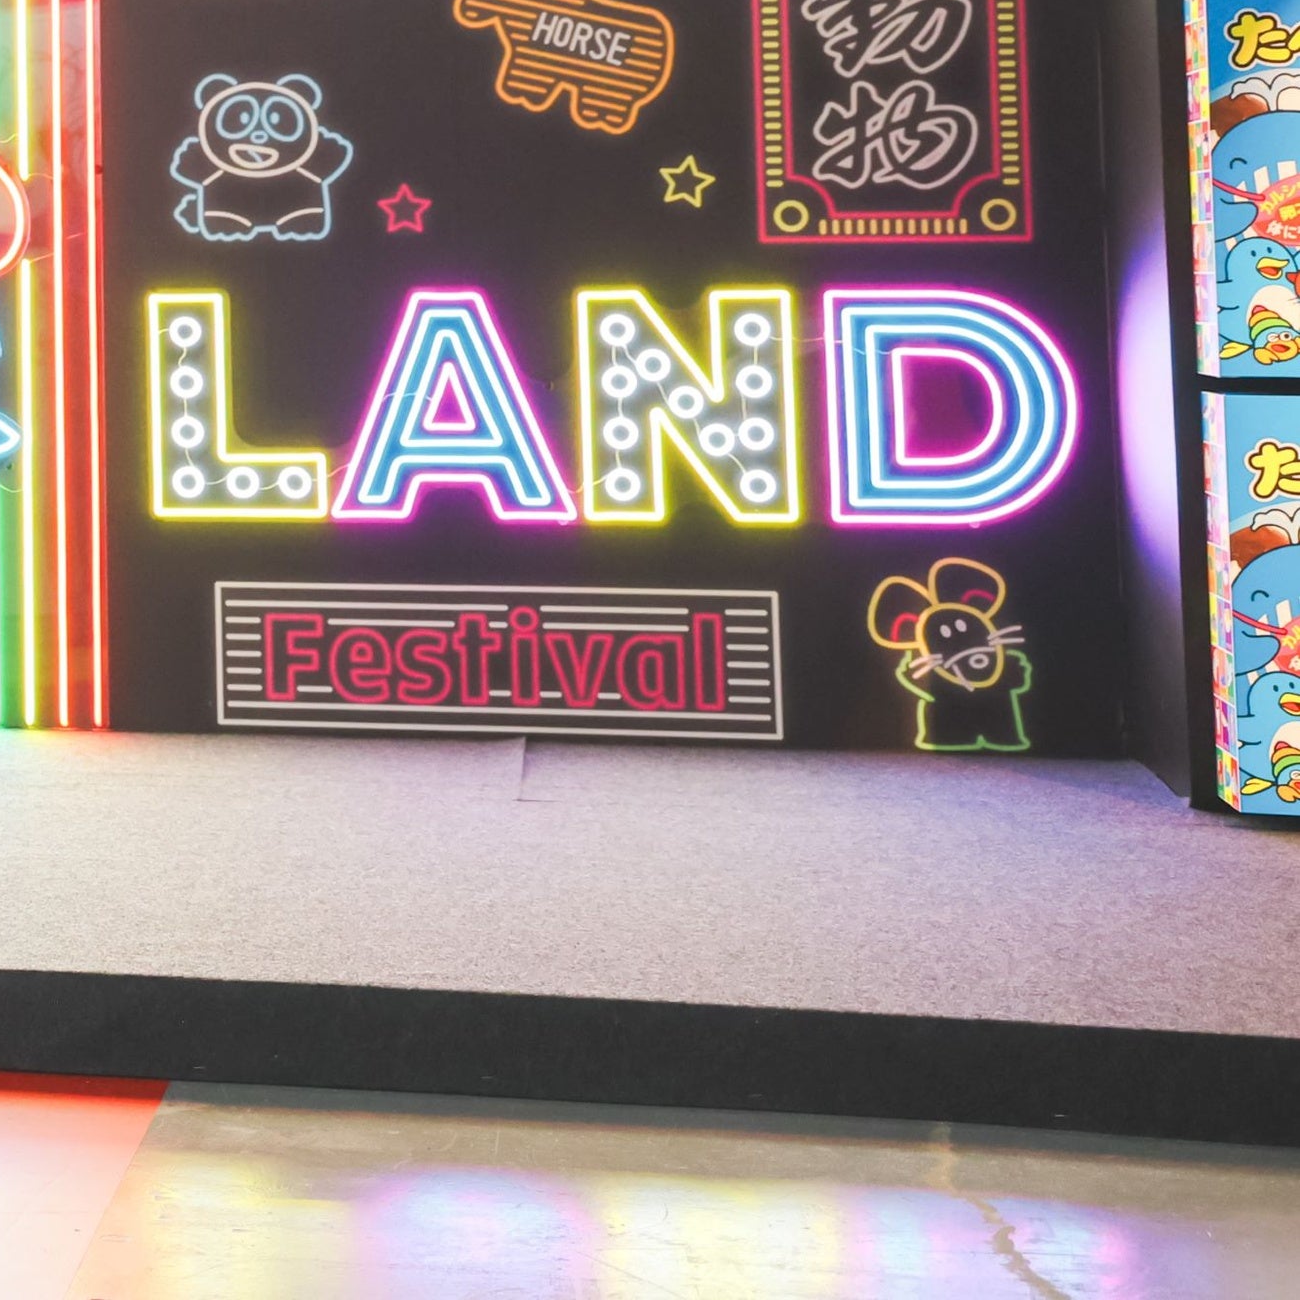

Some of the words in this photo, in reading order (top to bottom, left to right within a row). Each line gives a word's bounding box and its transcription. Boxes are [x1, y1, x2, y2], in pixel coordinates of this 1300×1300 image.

[531, 11, 631, 67] HORSE
[1226, 10, 1300, 68] た
[147, 288, 1079, 525] LAND
[261, 606, 728, 713] Festival
